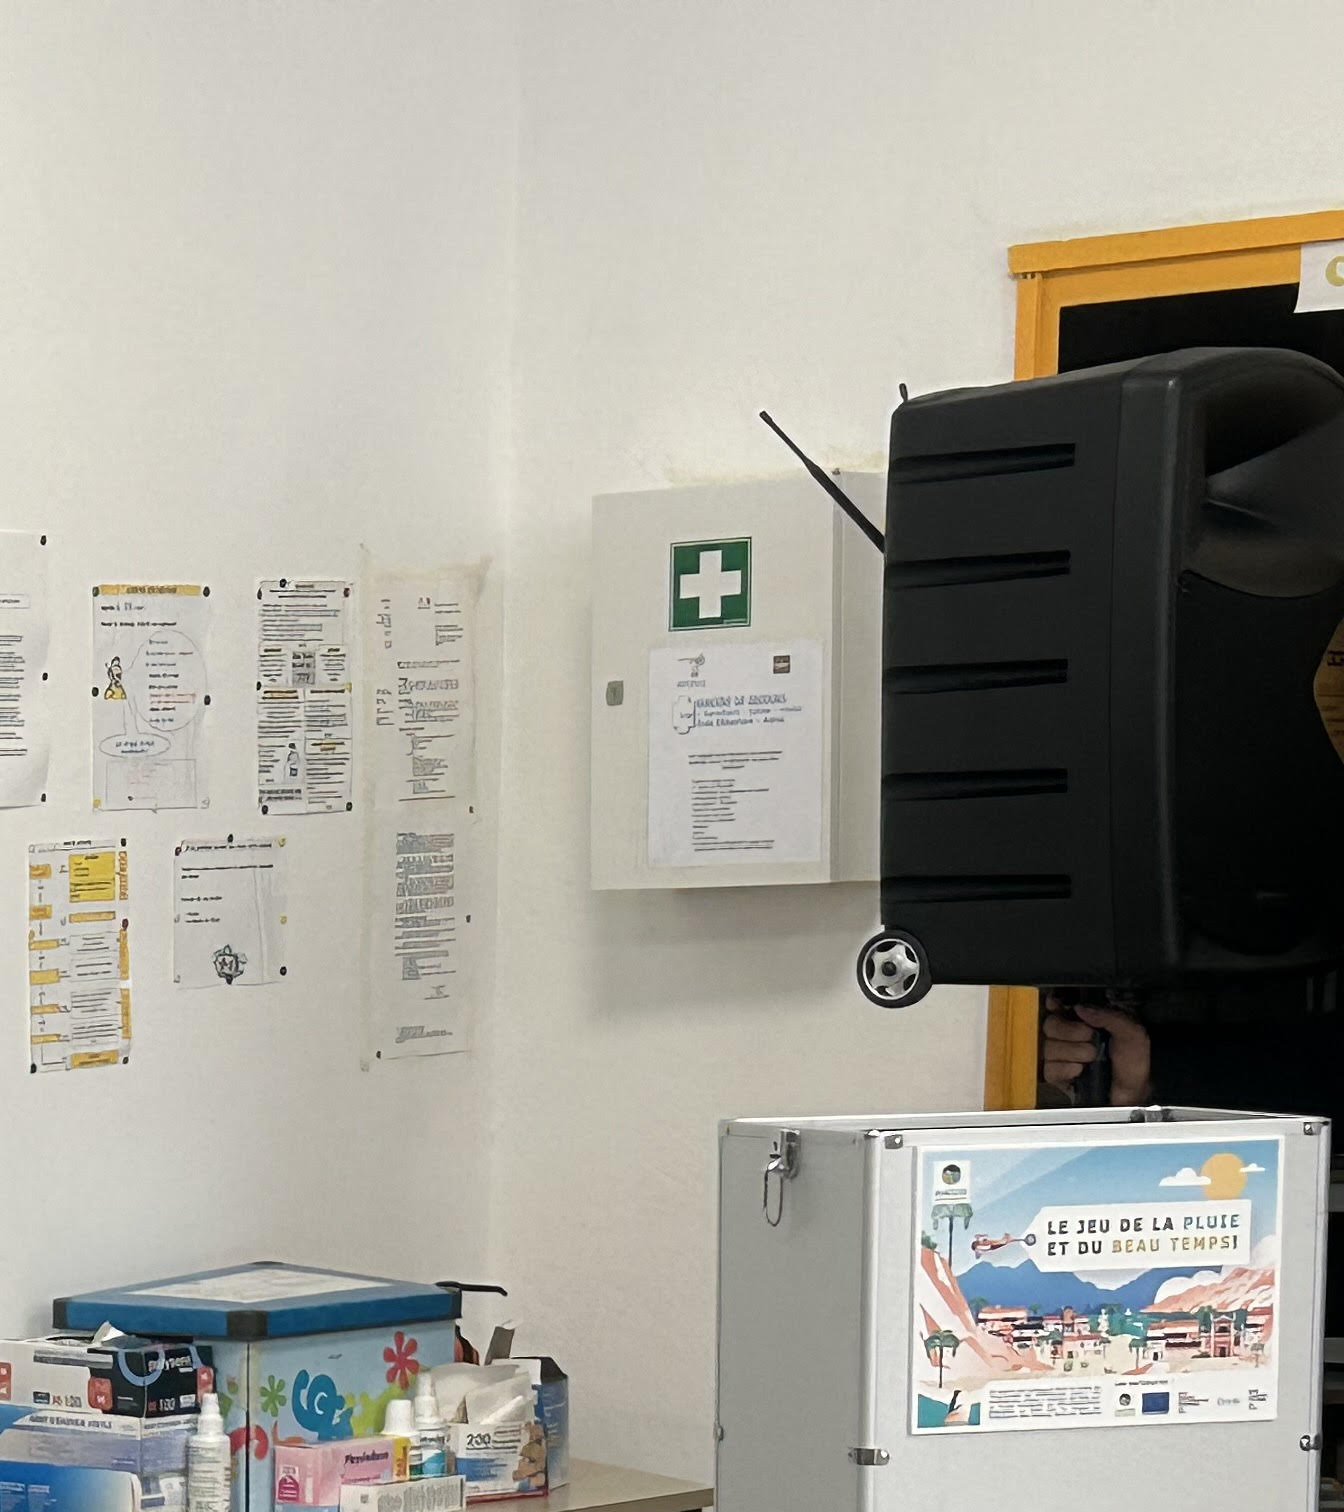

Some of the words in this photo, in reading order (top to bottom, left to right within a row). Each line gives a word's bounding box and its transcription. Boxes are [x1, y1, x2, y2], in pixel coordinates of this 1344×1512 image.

[1048, 1220, 1069, 1236] LE
[1076, 1219, 1110, 1235] JEU
[1120, 1217, 1143, 1233] DE
[1152, 1216, 1174, 1232] LA
[1183, 1214, 1241, 1230] PLUIE
[1047, 1241, 1070, 1257] ET
[1078, 1240, 1102, 1255] DU
[1112, 1237, 1160, 1254] BEAU
